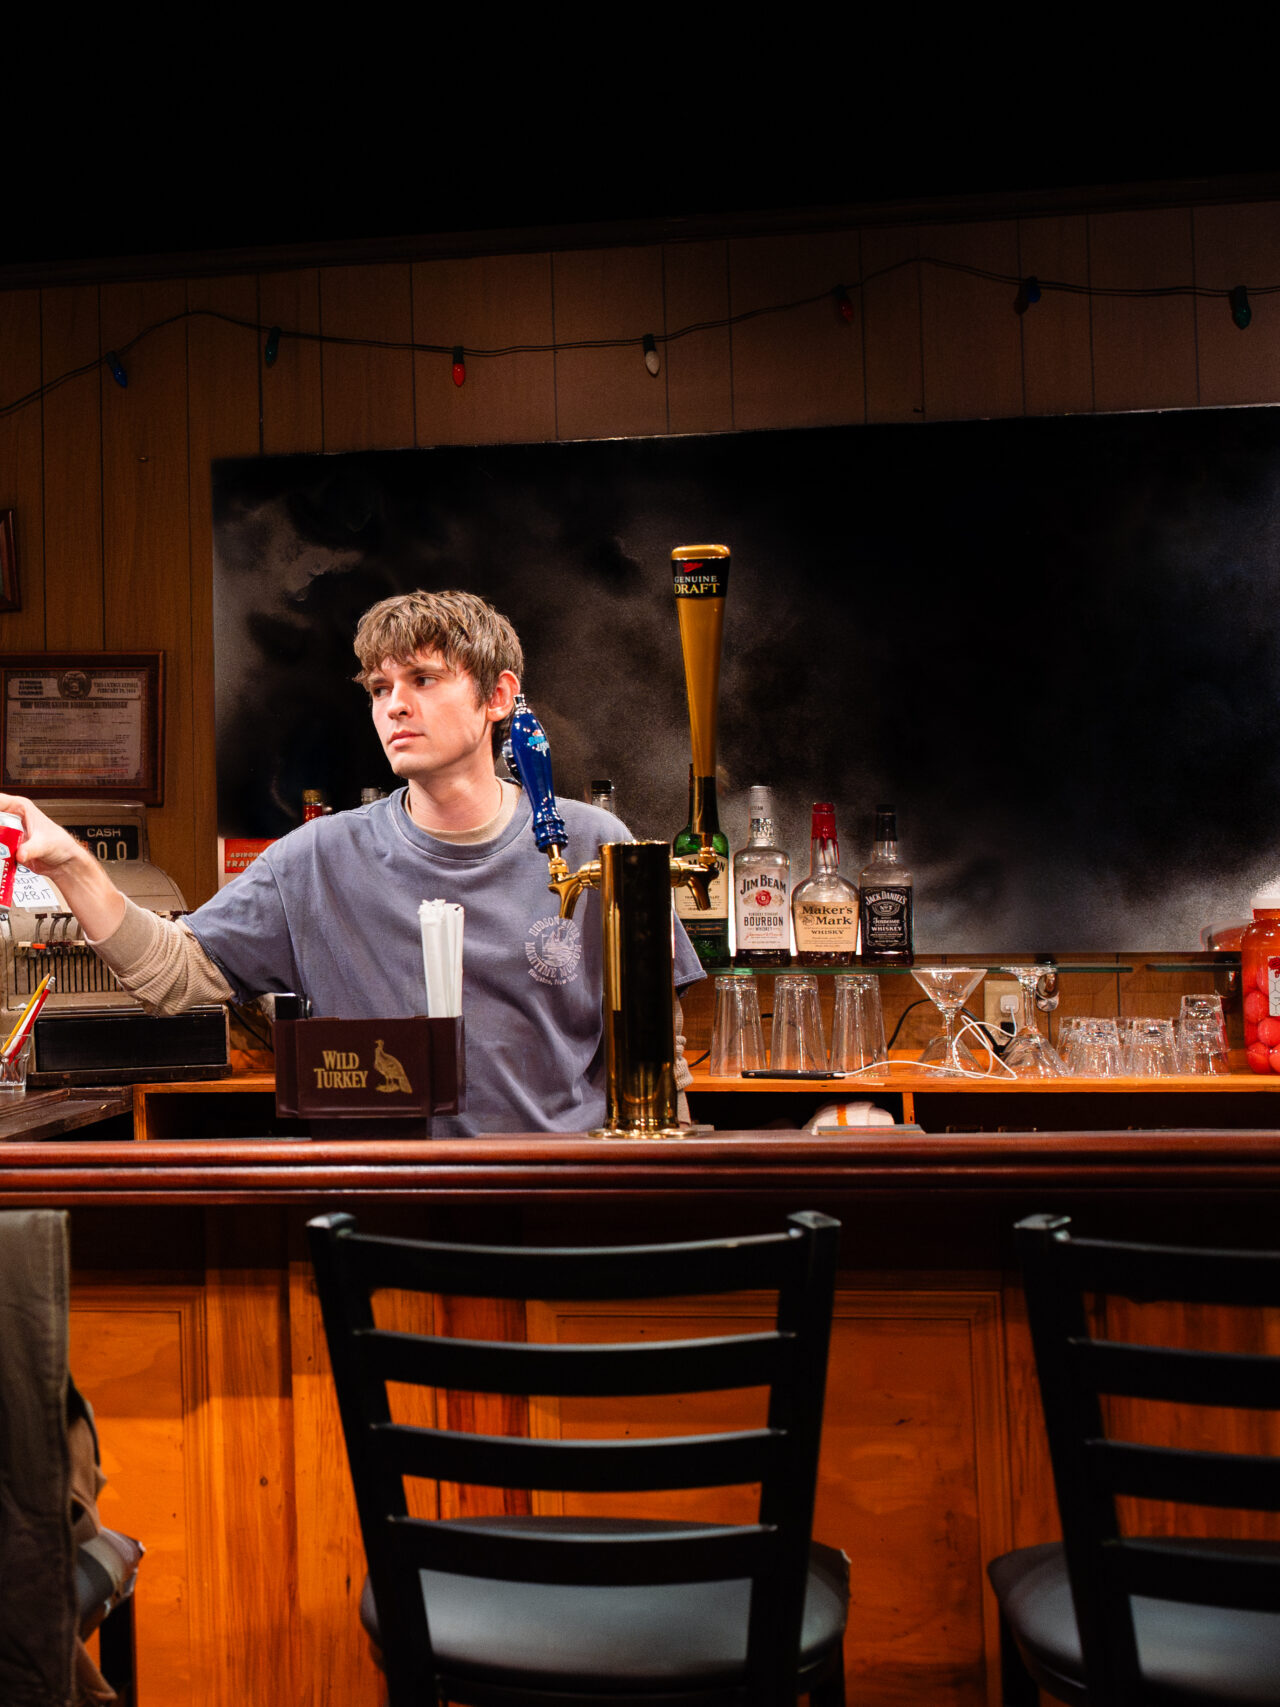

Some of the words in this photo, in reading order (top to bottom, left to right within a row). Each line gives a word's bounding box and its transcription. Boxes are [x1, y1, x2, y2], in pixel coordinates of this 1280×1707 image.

[674, 575, 718, 583] GENUINE
[674, 583, 720, 594] DRAFT
[87, 828, 121, 838] CASH
[740, 878, 758, 895] JIM
[760, 874, 787, 894] BEAM
[14, 888, 51, 902] DEBIT
[865, 892, 881, 906] JACK
[802, 906, 853, 915] Maker's
[528, 915, 560, 937] HUDSON
[744, 916, 784, 927] BOURBON
[816, 916, 852, 925] Mark
[322, 1050, 360, 1070] WILD
[313, 1068, 368, 1089] TURKEY
